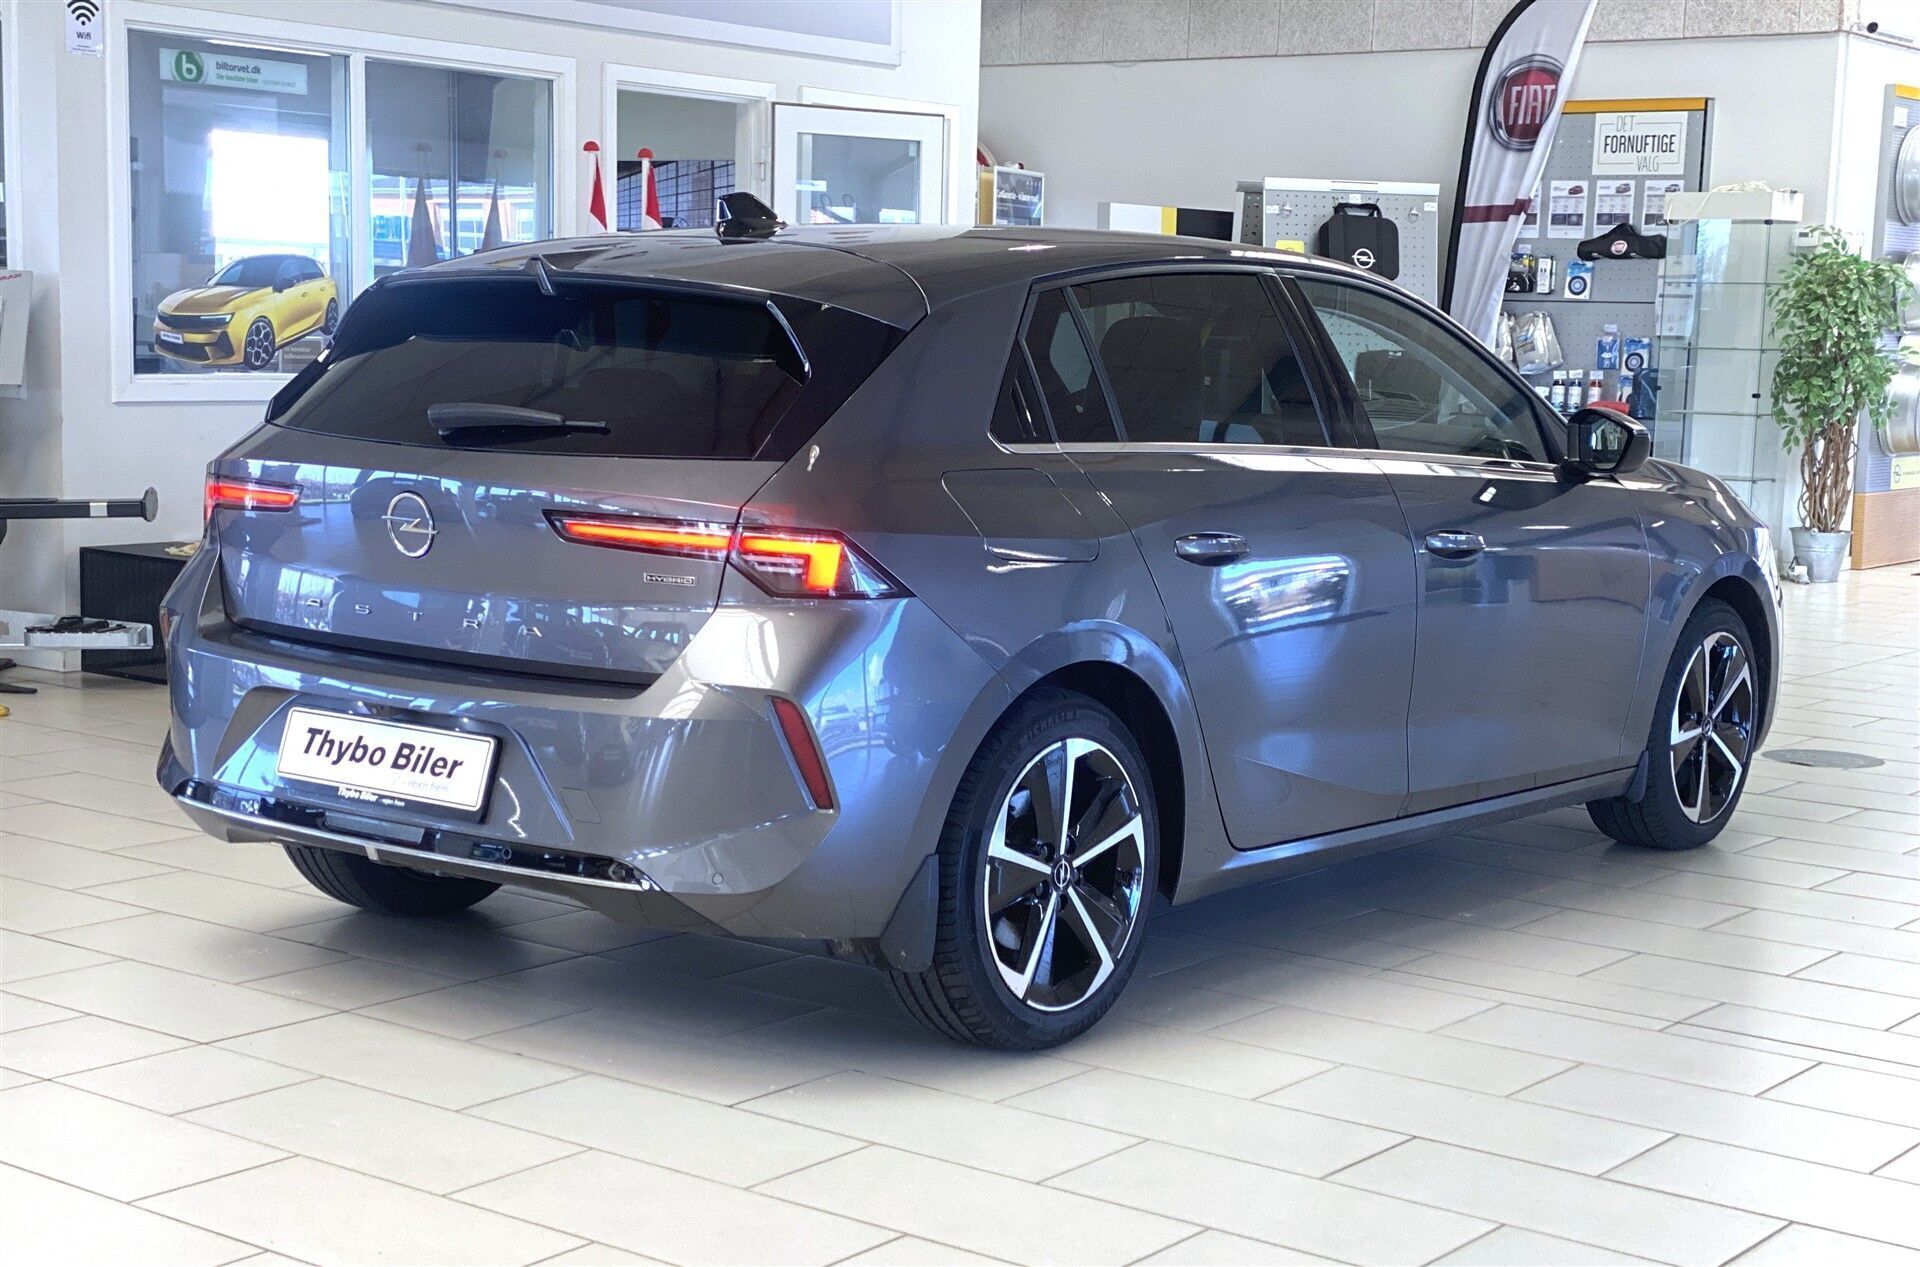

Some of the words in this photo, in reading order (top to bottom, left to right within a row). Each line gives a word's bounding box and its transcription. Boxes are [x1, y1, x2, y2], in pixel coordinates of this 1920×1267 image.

[76, 31, 92, 40] Wifi
[215, 61, 262, 75] biltorvet.dk
[1508, 84, 1557, 125] FIAT
[1616, 115, 1637, 132] DET
[1603, 134, 1677, 154] FORNUFTIGE
[1636, 155, 1660, 172] VALG
[646, 574, 693, 585] HYBRID
[303, 727, 386, 766] Thybo
[390, 742, 464, 779] Biler
[338, 787, 360, 799] Thybo
[360, 791, 379, 802] Biler
